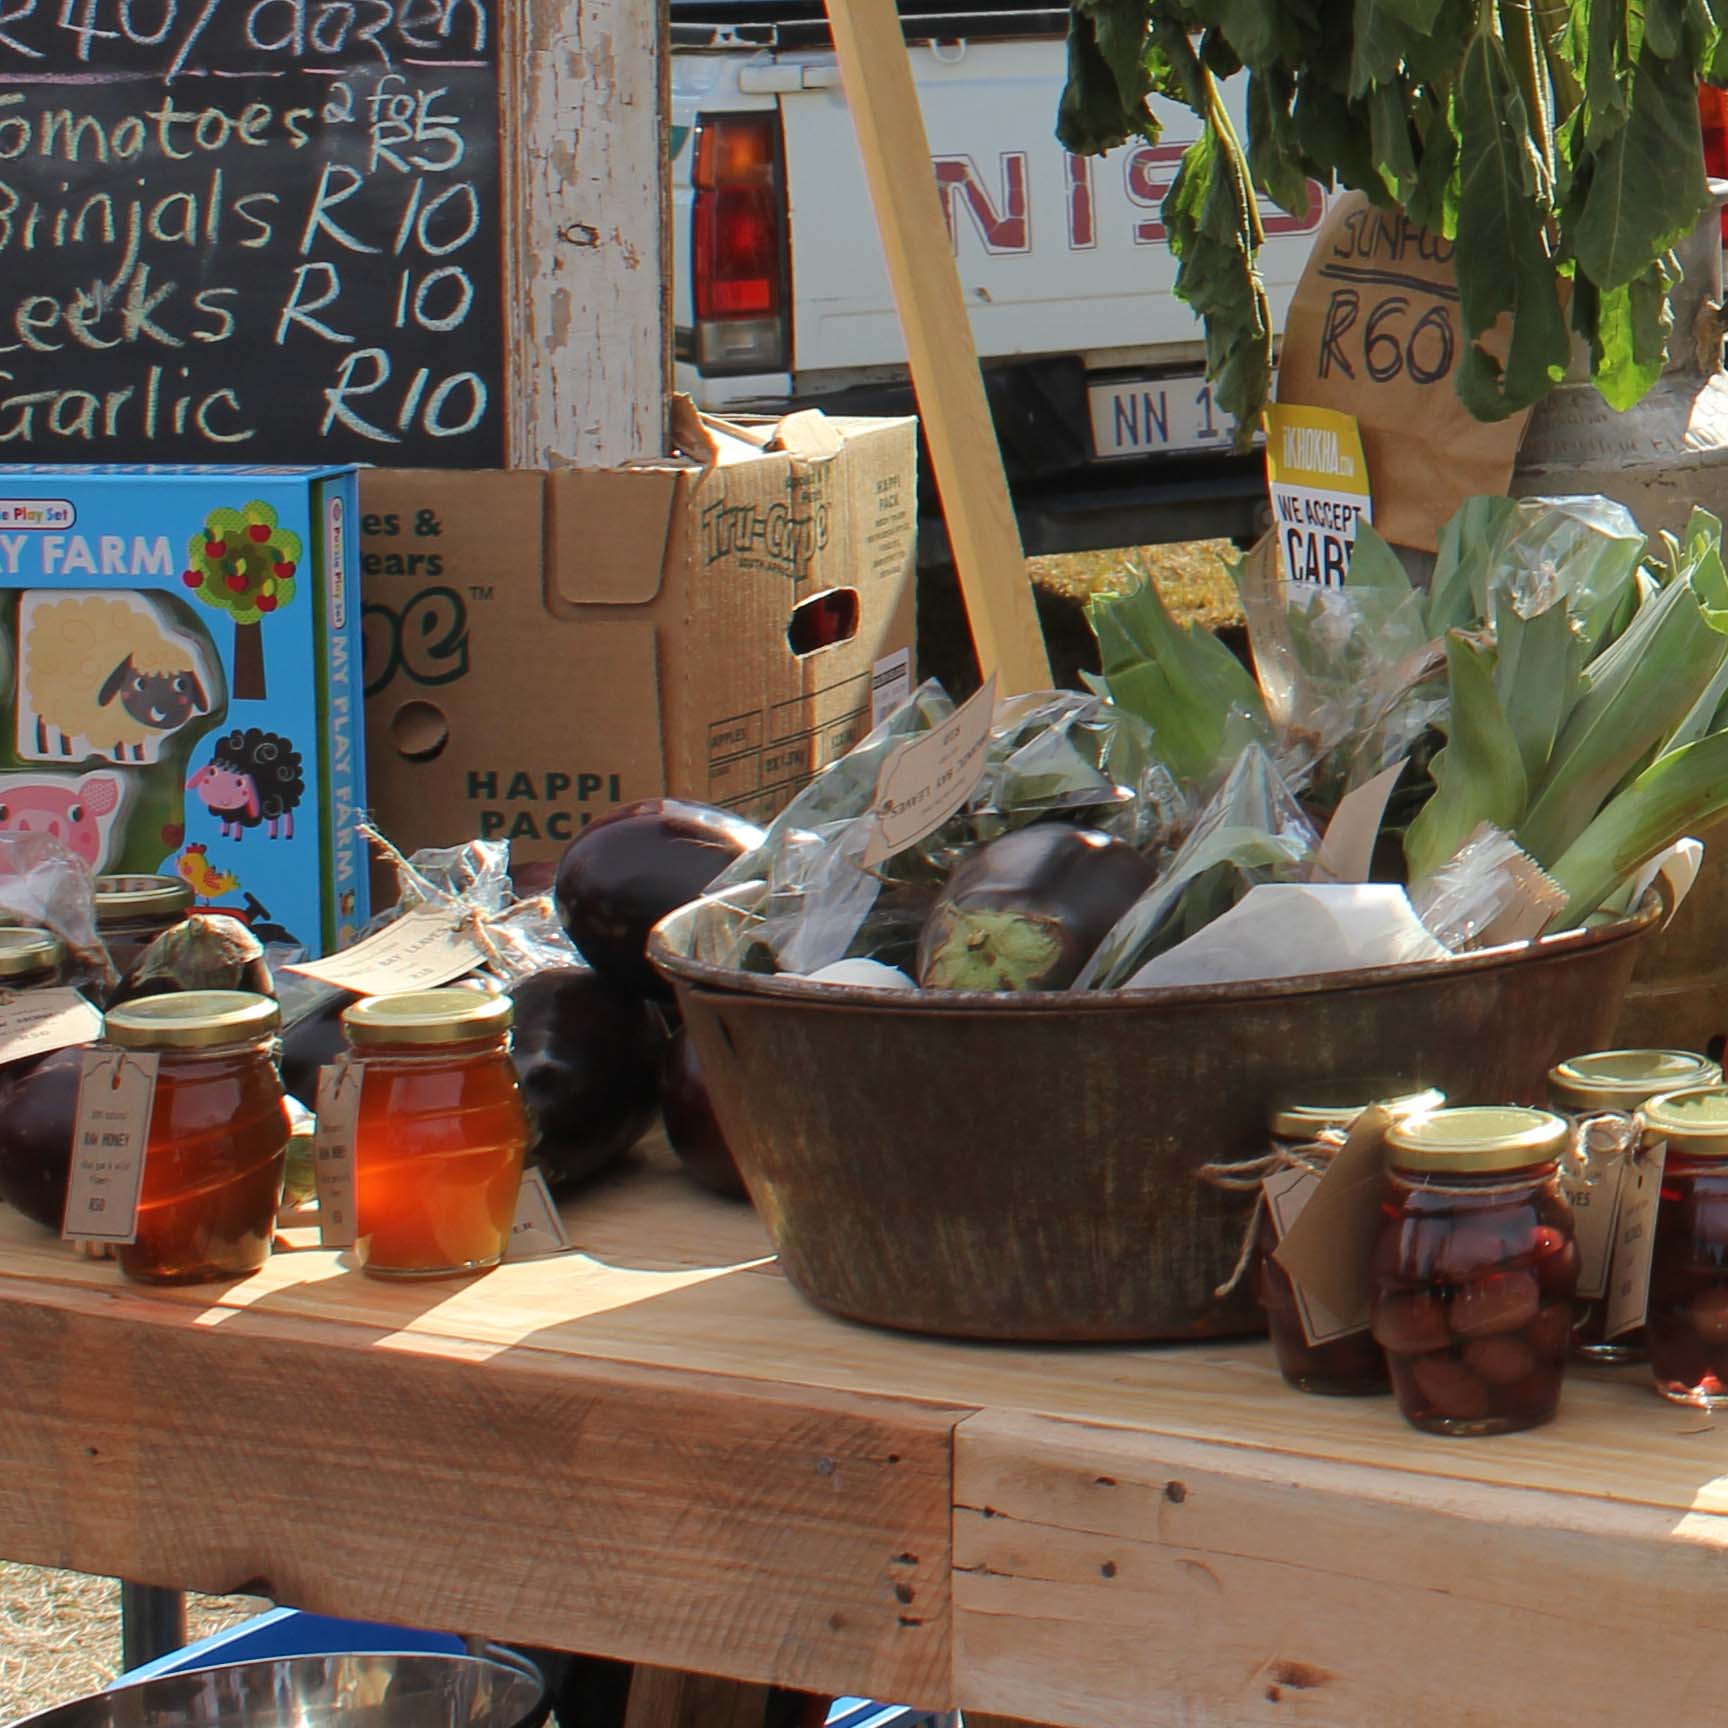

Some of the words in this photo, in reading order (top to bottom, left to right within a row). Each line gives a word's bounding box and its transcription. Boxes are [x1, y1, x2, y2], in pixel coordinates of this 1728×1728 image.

[322, 86, 356, 126] 2
[1334, 209, 1456, 263] SUNFLO
[0, 262, 241, 350] eeks
[1318, 288, 1456, 384] R60
[318, 348, 489, 445] R10
[1113, 391, 1169, 447] NN
[13, 506, 44, 523] Play
[46, 506, 69, 522] Set
[414, 508, 443, 538] &
[1277, 493, 1302, 525] WE
[1305, 498, 1362, 534] ACCEPT
[41, 535, 175, 576] FARM
[361, 551, 443, 576] ears
[1287, 527, 1355, 593] CAR
[331, 634, 350, 686] MY
[332, 694, 352, 776] PLAY
[466, 770, 622, 802] HAPPI
[334, 785, 356, 882] FARM
[480, 810, 593, 840] PAC
